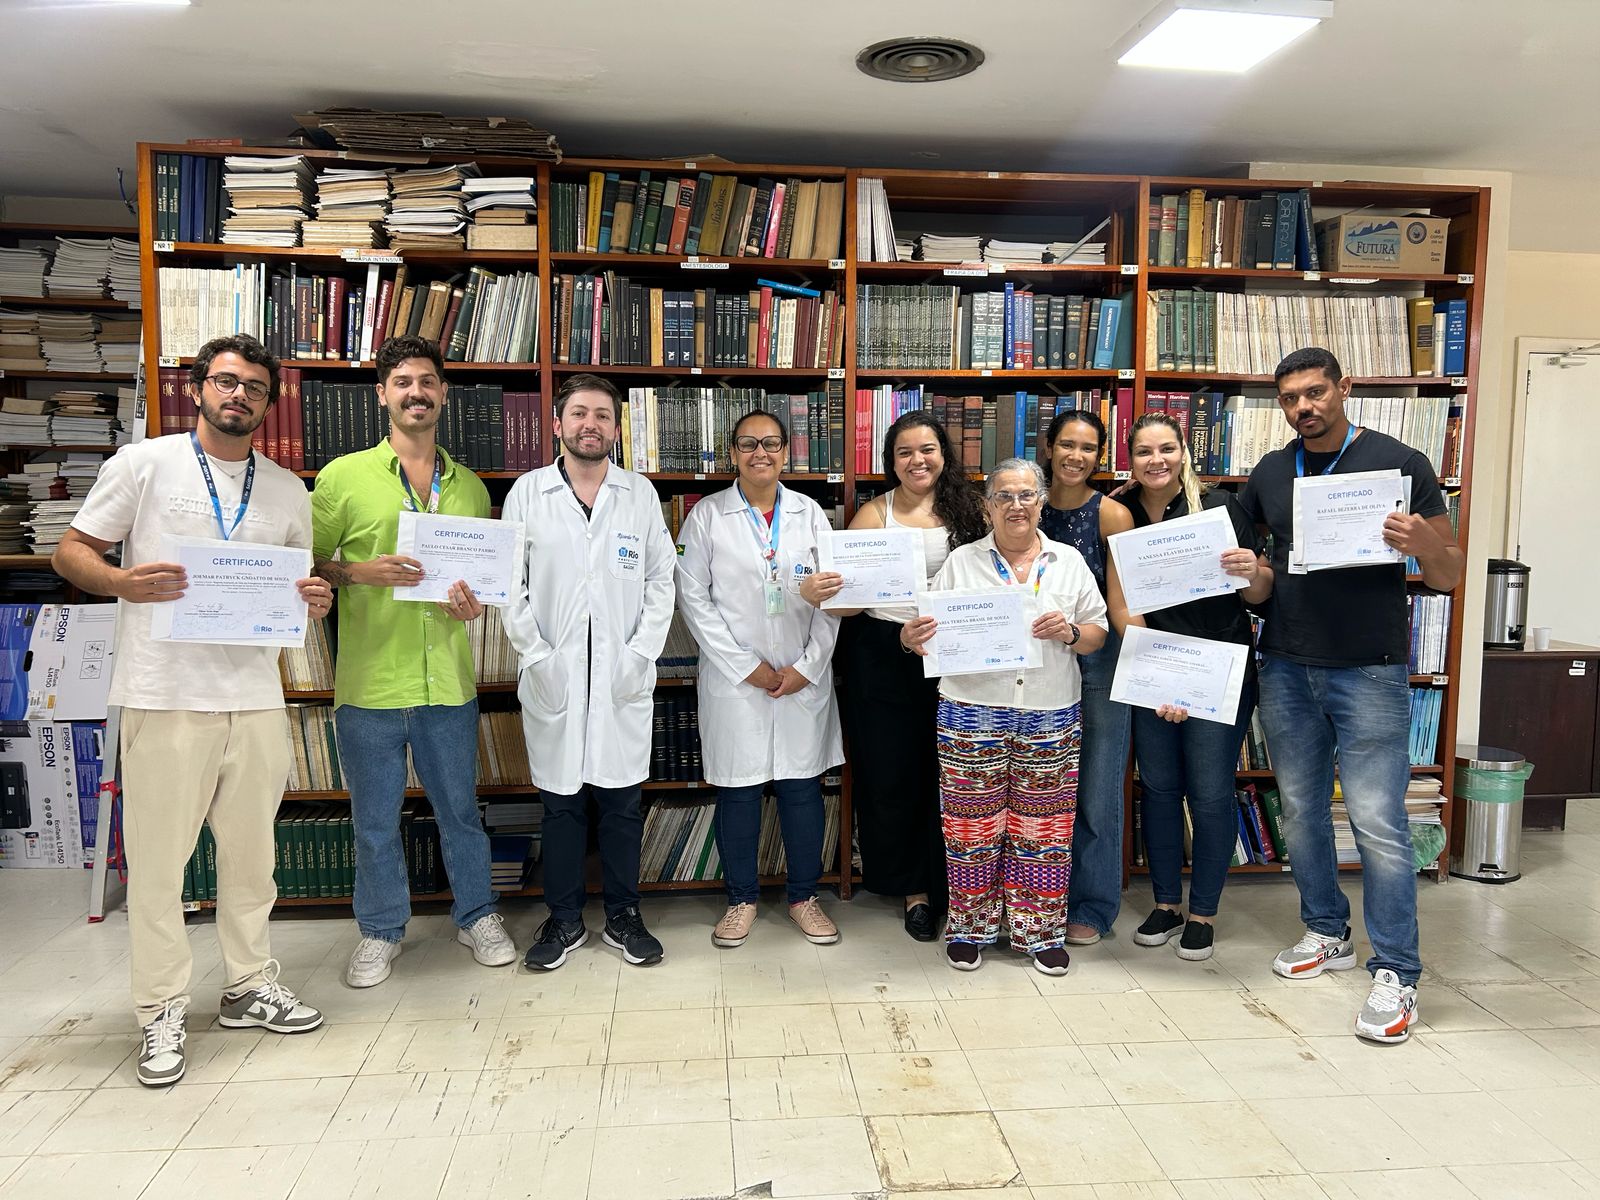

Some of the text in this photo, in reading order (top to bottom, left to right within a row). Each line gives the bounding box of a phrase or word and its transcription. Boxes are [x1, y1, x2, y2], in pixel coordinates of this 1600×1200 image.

[1356, 242, 1396, 255] FUTURA
[1327, 489, 1373, 500] CERTIFICADO
[434, 530, 485, 540] CERTIFICADO
[1147, 532, 1196, 547] CERTIFICADO
[844, 540, 887, 549] CERTIFICADO
[628, 550, 639, 560] Rio
[212, 557, 273, 567] CERTIFICADO
[804, 566, 813, 575] Rio
[947, 602, 994, 612] CERTIFICADO
[56, 607, 70, 642] EPSON
[1152, 642, 1201, 656] CERTIFICADO
[52, 668, 60, 687] EcoTank
[1181, 700, 1191, 708] Rio
[63, 727, 71, 751] EPSON
[42, 726, 56, 768] EPSON
[56, 841, 64, 864] L14150
[1316, 947, 1339, 964] FILA
[1400, 997, 1414, 1019] FILA
